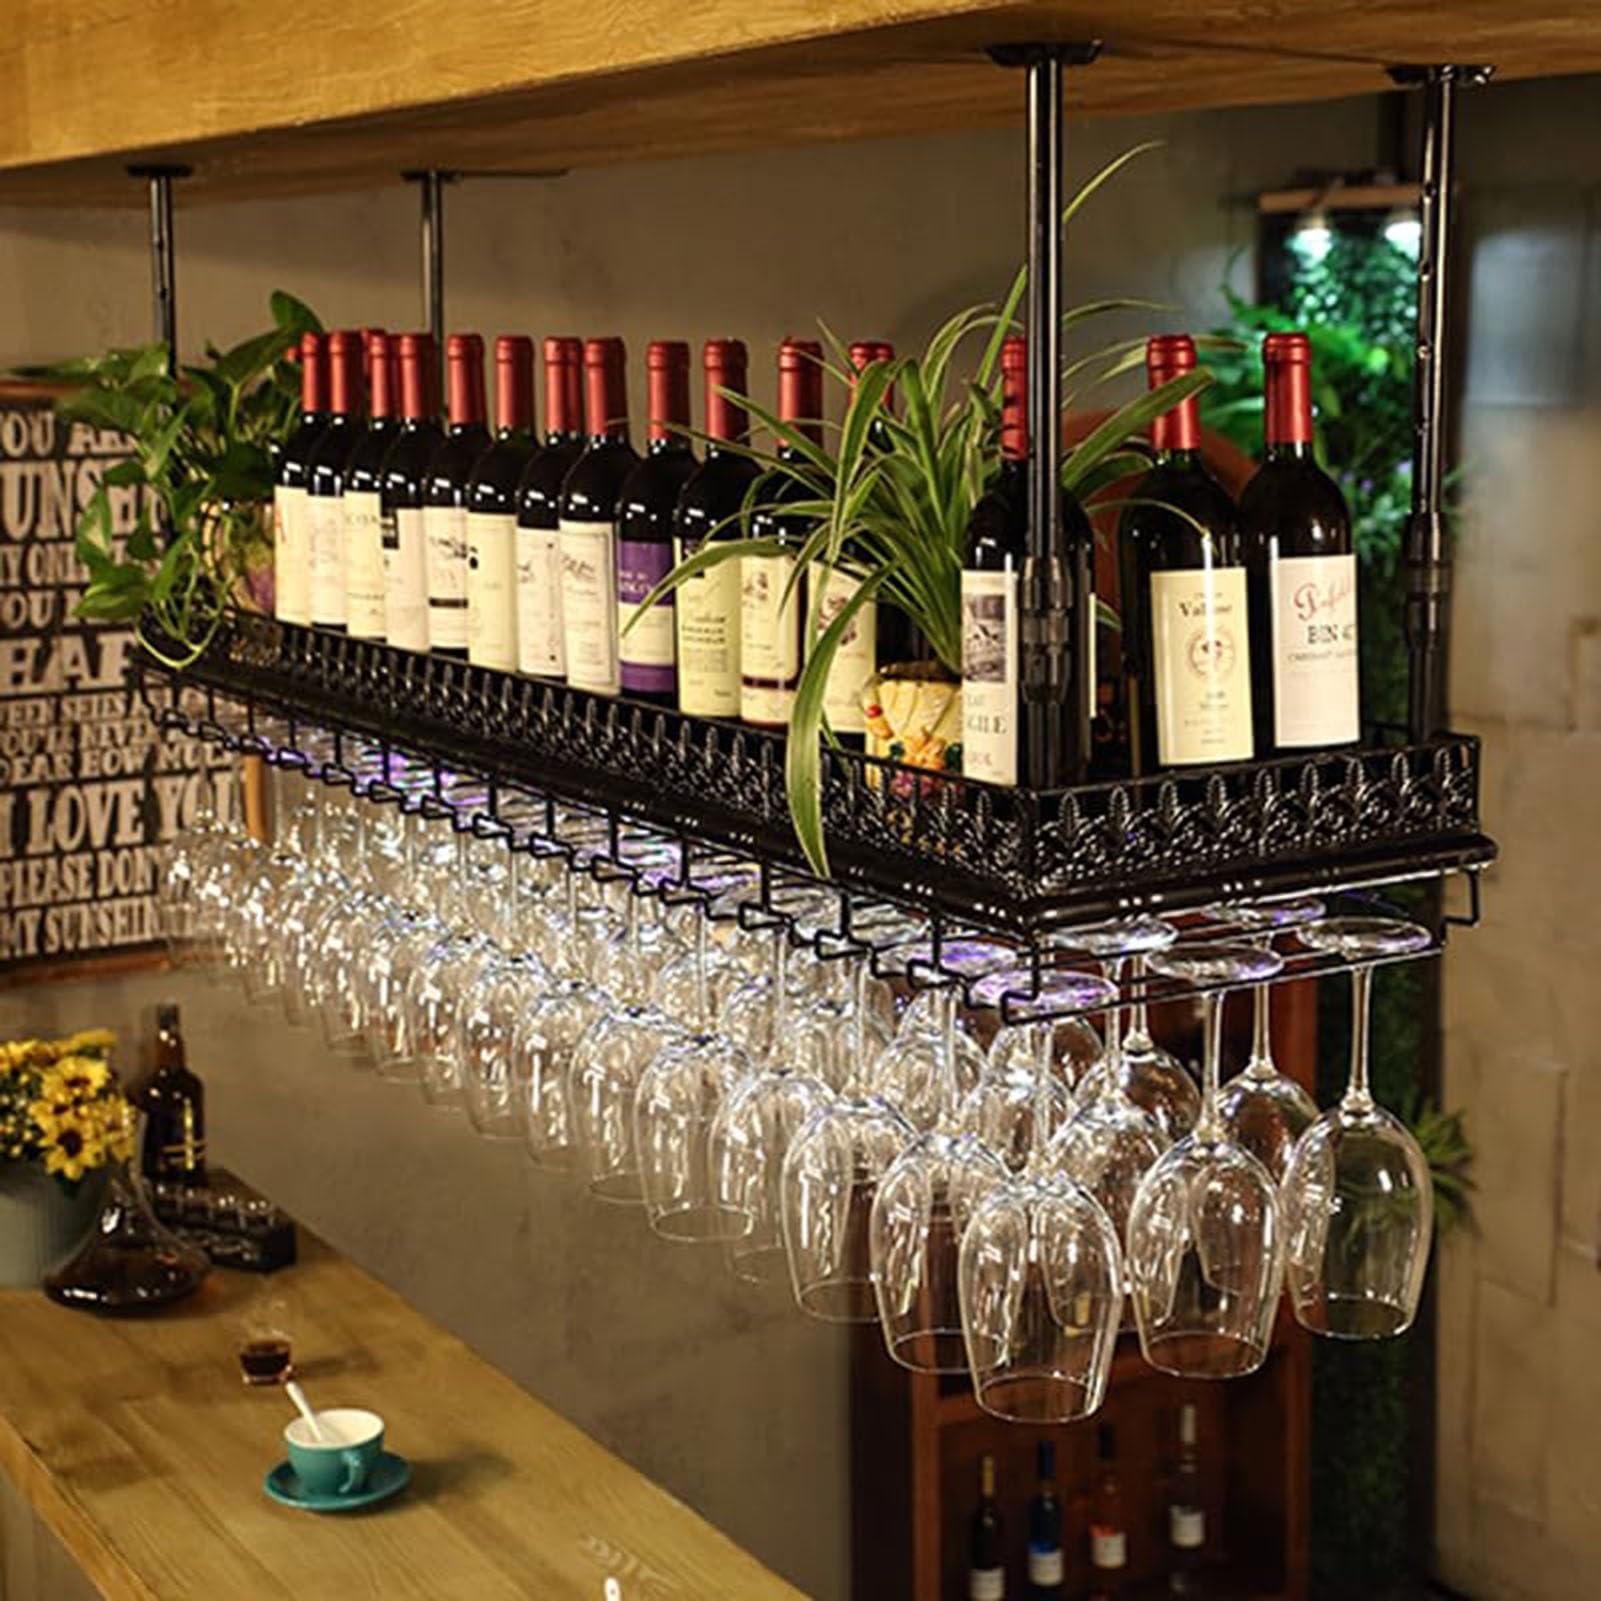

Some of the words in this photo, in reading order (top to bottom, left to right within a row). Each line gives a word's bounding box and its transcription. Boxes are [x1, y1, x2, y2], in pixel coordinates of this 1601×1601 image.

[0, 411, 55, 457] OU
[0, 590, 55, 628] OU
[27, 780, 145, 853] LOVE
